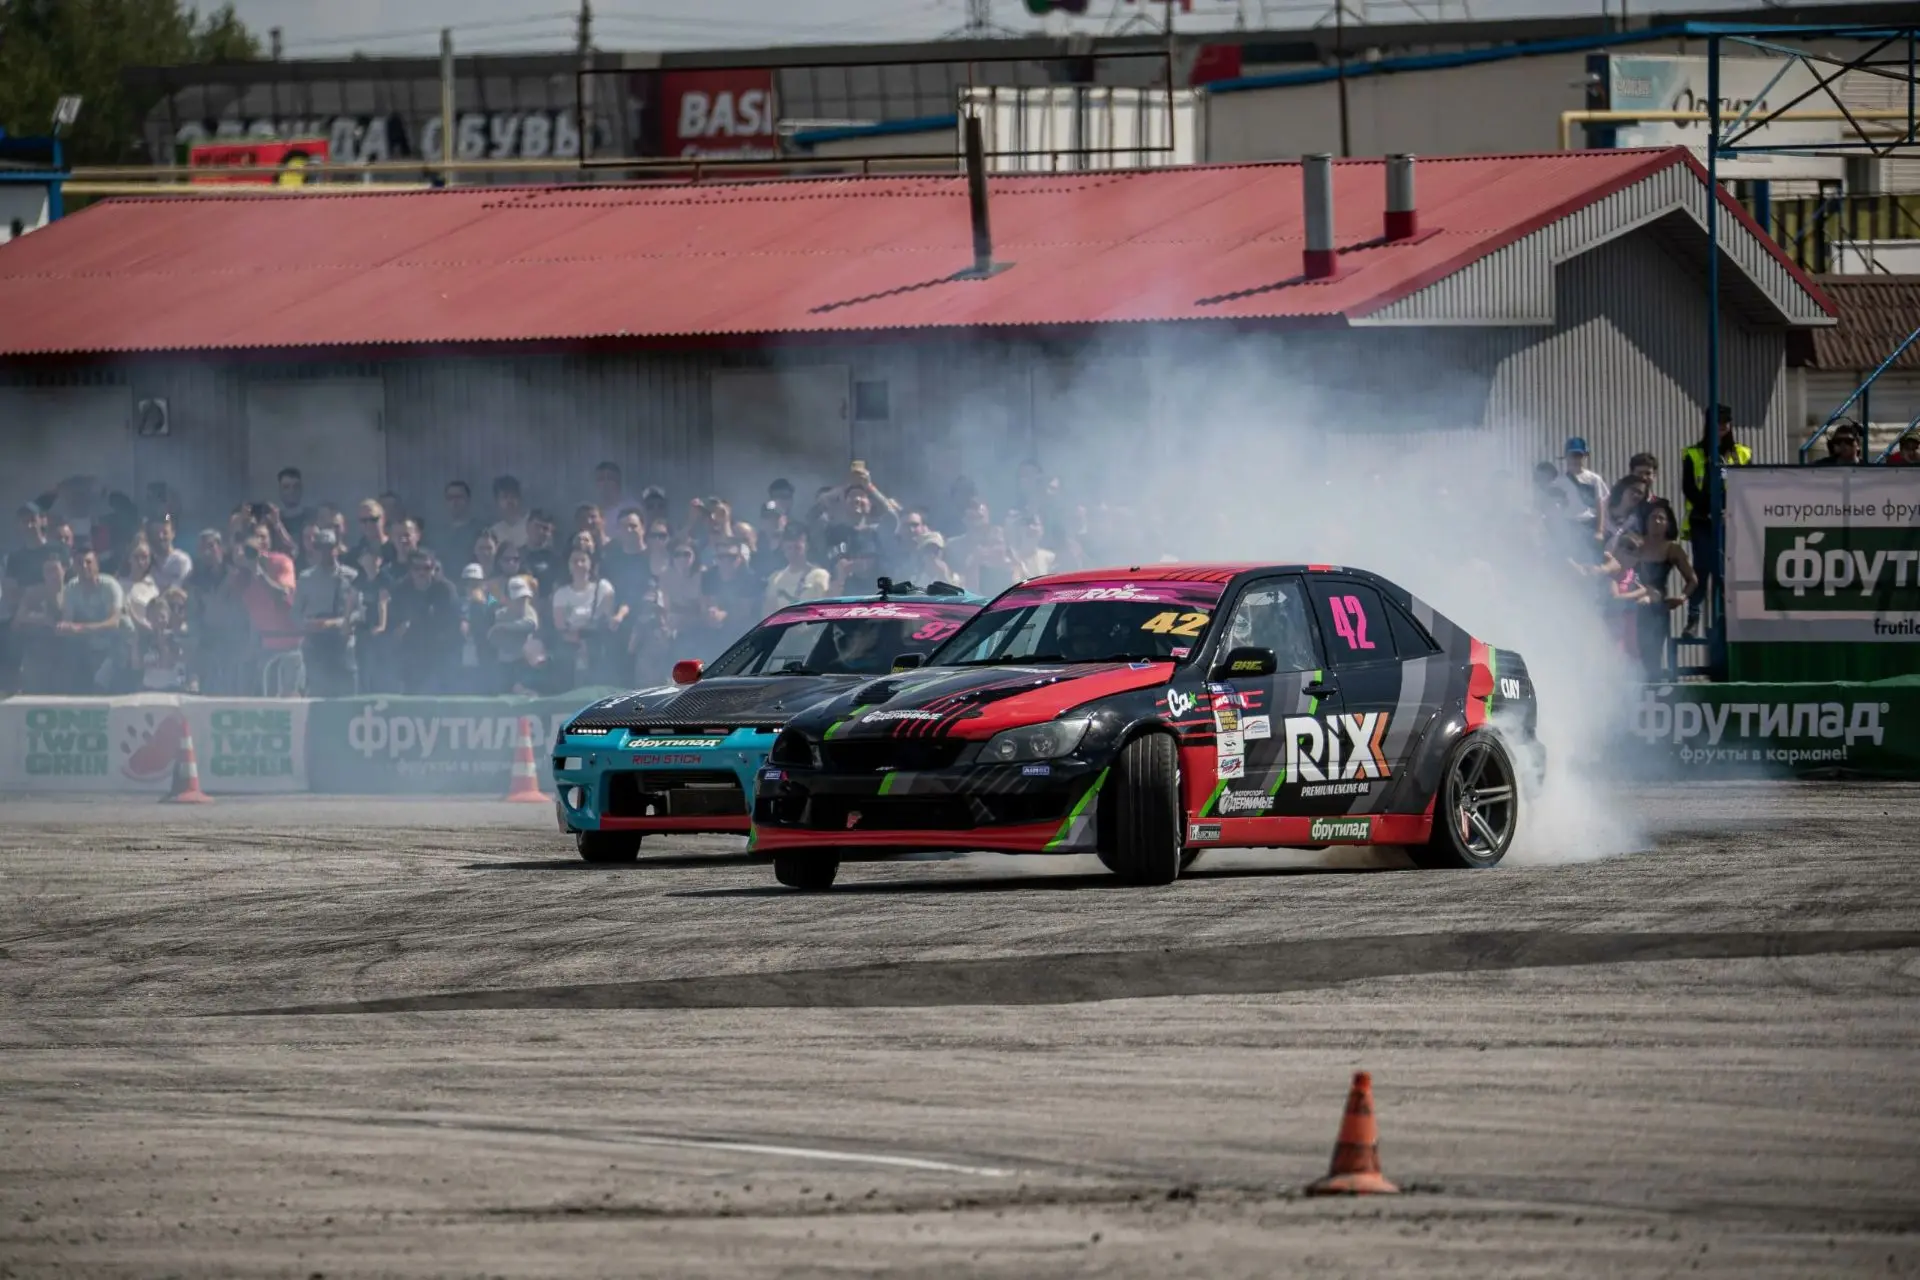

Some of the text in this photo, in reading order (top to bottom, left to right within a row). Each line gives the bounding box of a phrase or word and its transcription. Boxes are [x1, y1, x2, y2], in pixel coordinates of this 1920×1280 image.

[1764, 498, 1920, 522] натуральные фру
[1776, 534, 1920, 597] фрут
[1141, 612, 1210, 637] 42
[1329, 595, 1376, 649] 42
[25, 708, 108, 731] ONE
[1635, 689, 1884, 746] фрутилад
[628, 737, 721, 749] фрутилад
[1679, 745, 1848, 765] фрукты в кармане!
[1301, 782, 1370, 797] PREMIUM ENGINE OIL
[1311, 818, 1370, 840] фрутилад
